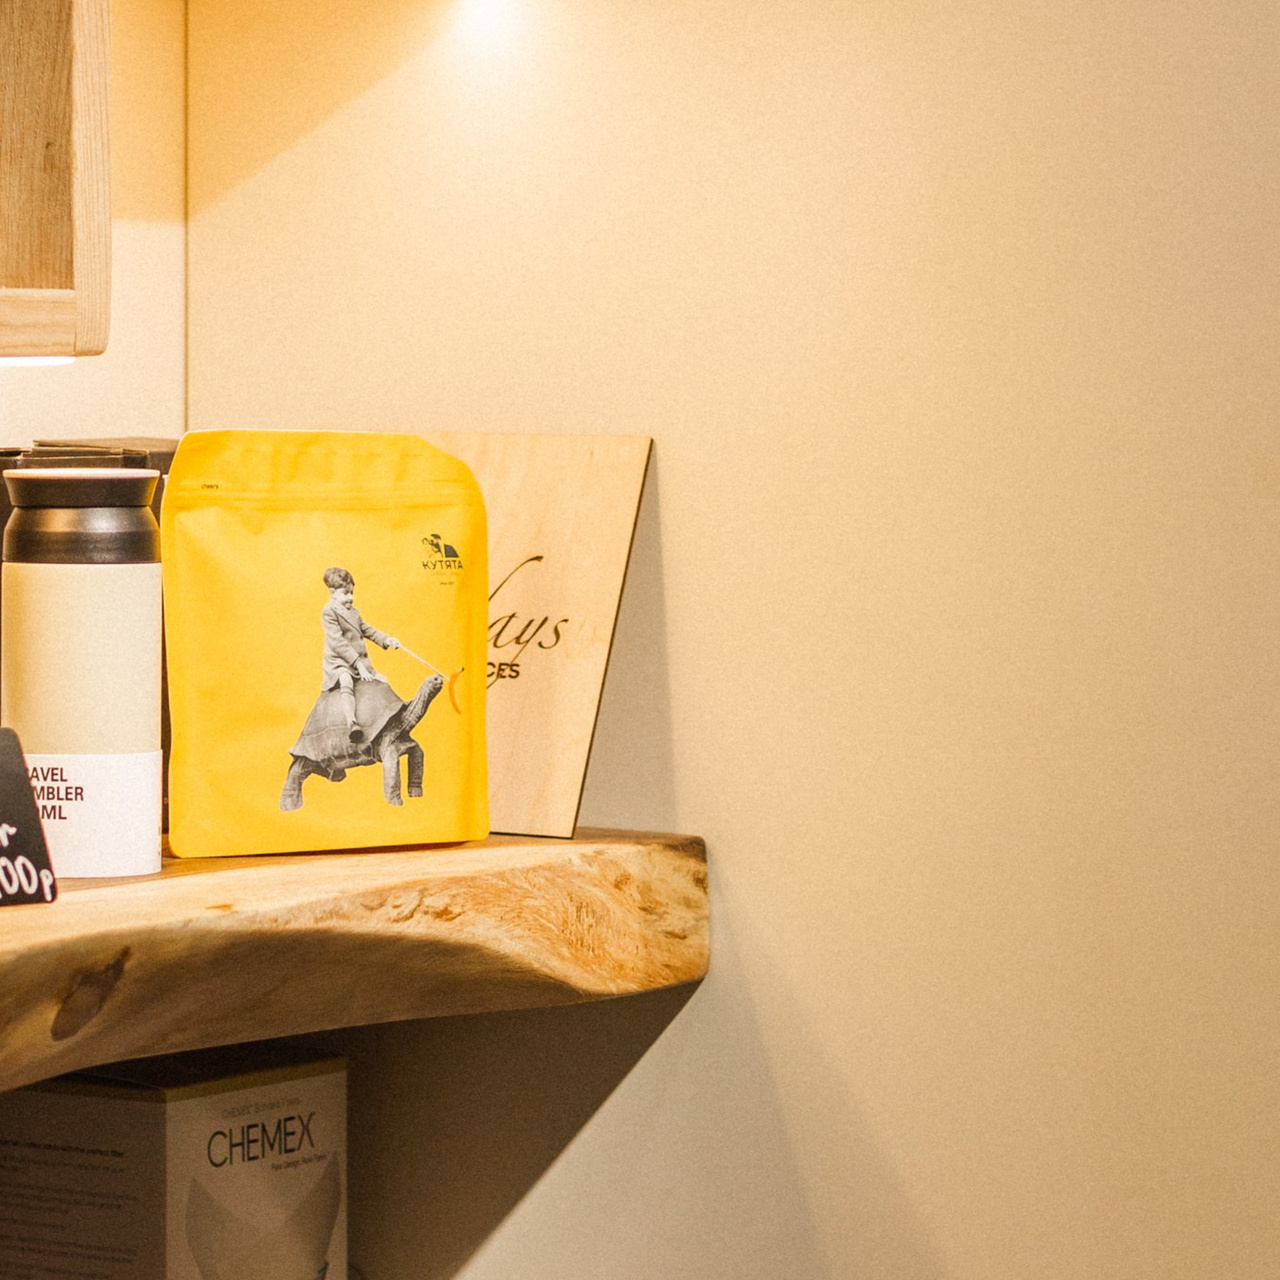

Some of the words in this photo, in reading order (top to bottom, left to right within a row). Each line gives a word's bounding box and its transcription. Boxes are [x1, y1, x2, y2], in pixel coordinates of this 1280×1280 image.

[422, 559, 463, 570] КУТЯТА
[487, 662, 520, 679] CES
[29, 767, 68, 782] AVEL
[34, 786, 84, 801] MBLER
[207, 1111, 316, 1168] CHEMEX
